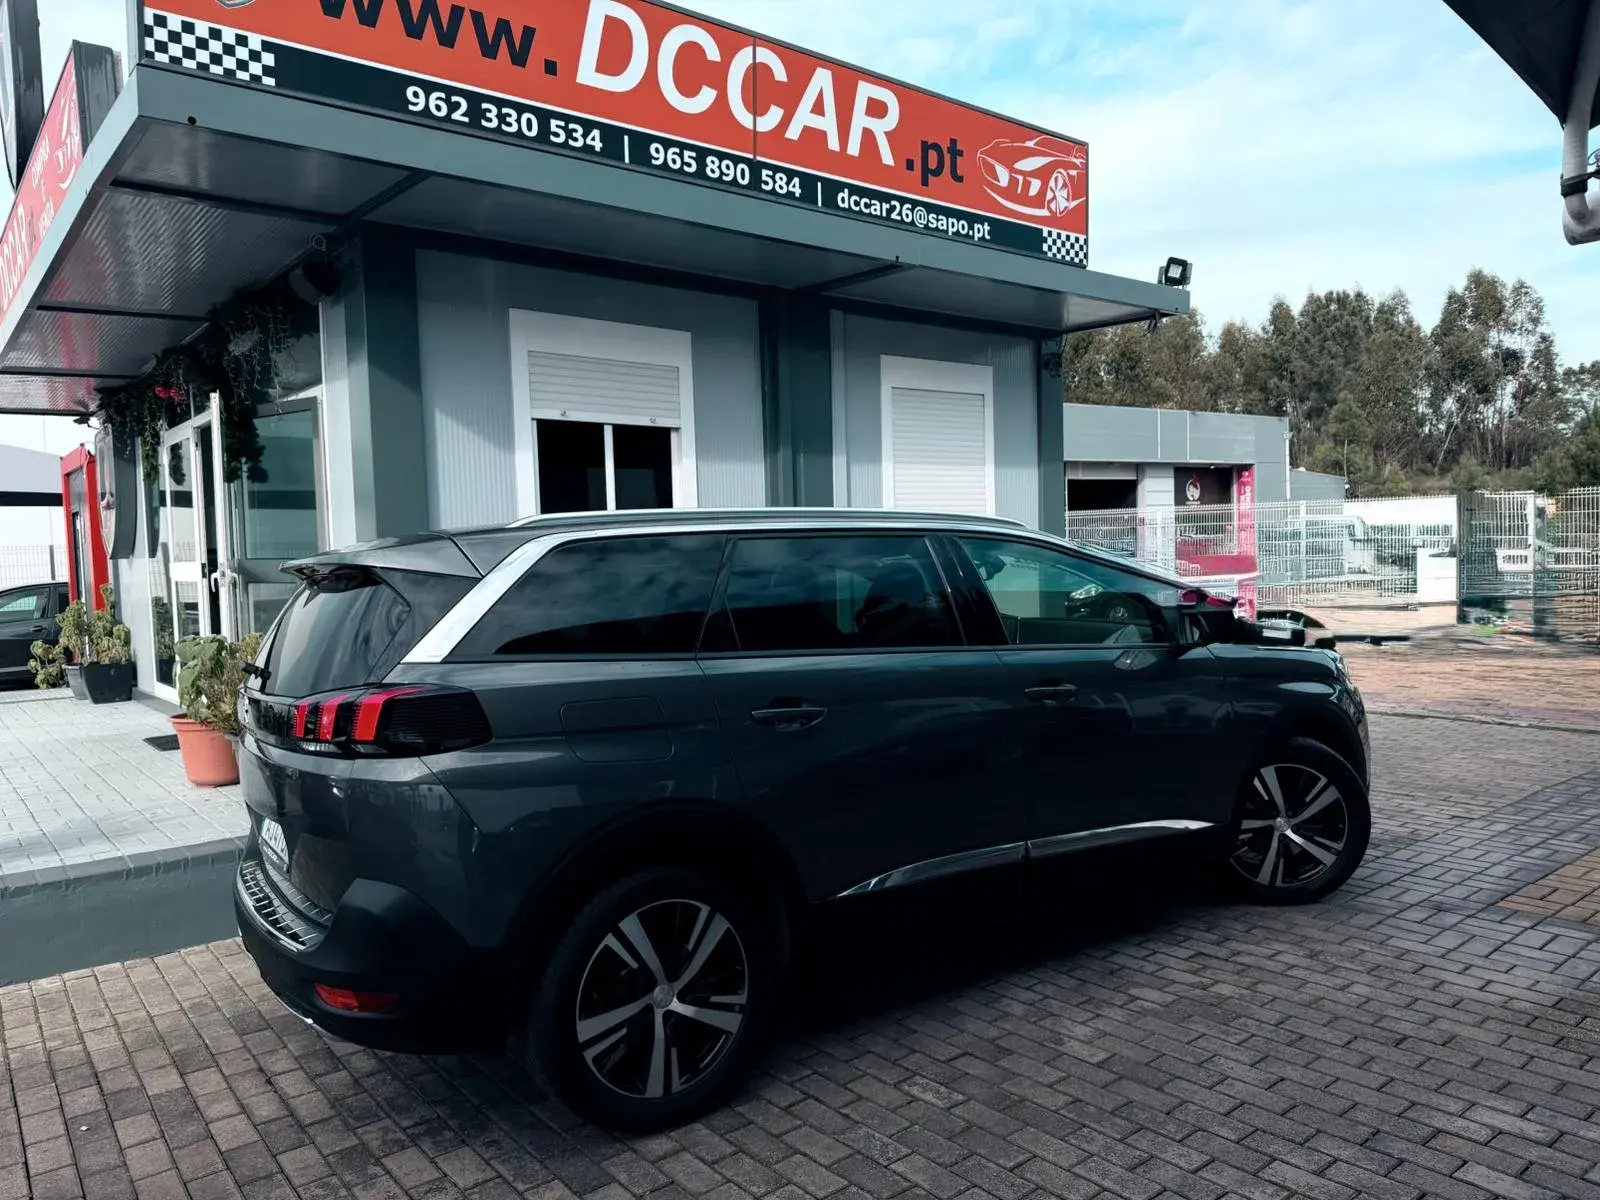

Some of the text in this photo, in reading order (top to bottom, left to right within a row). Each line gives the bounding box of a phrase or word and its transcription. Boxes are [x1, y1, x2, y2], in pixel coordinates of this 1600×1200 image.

[405, 86, 991, 241] 962 330 534 965 890 584 dccar26@sapo.pt
